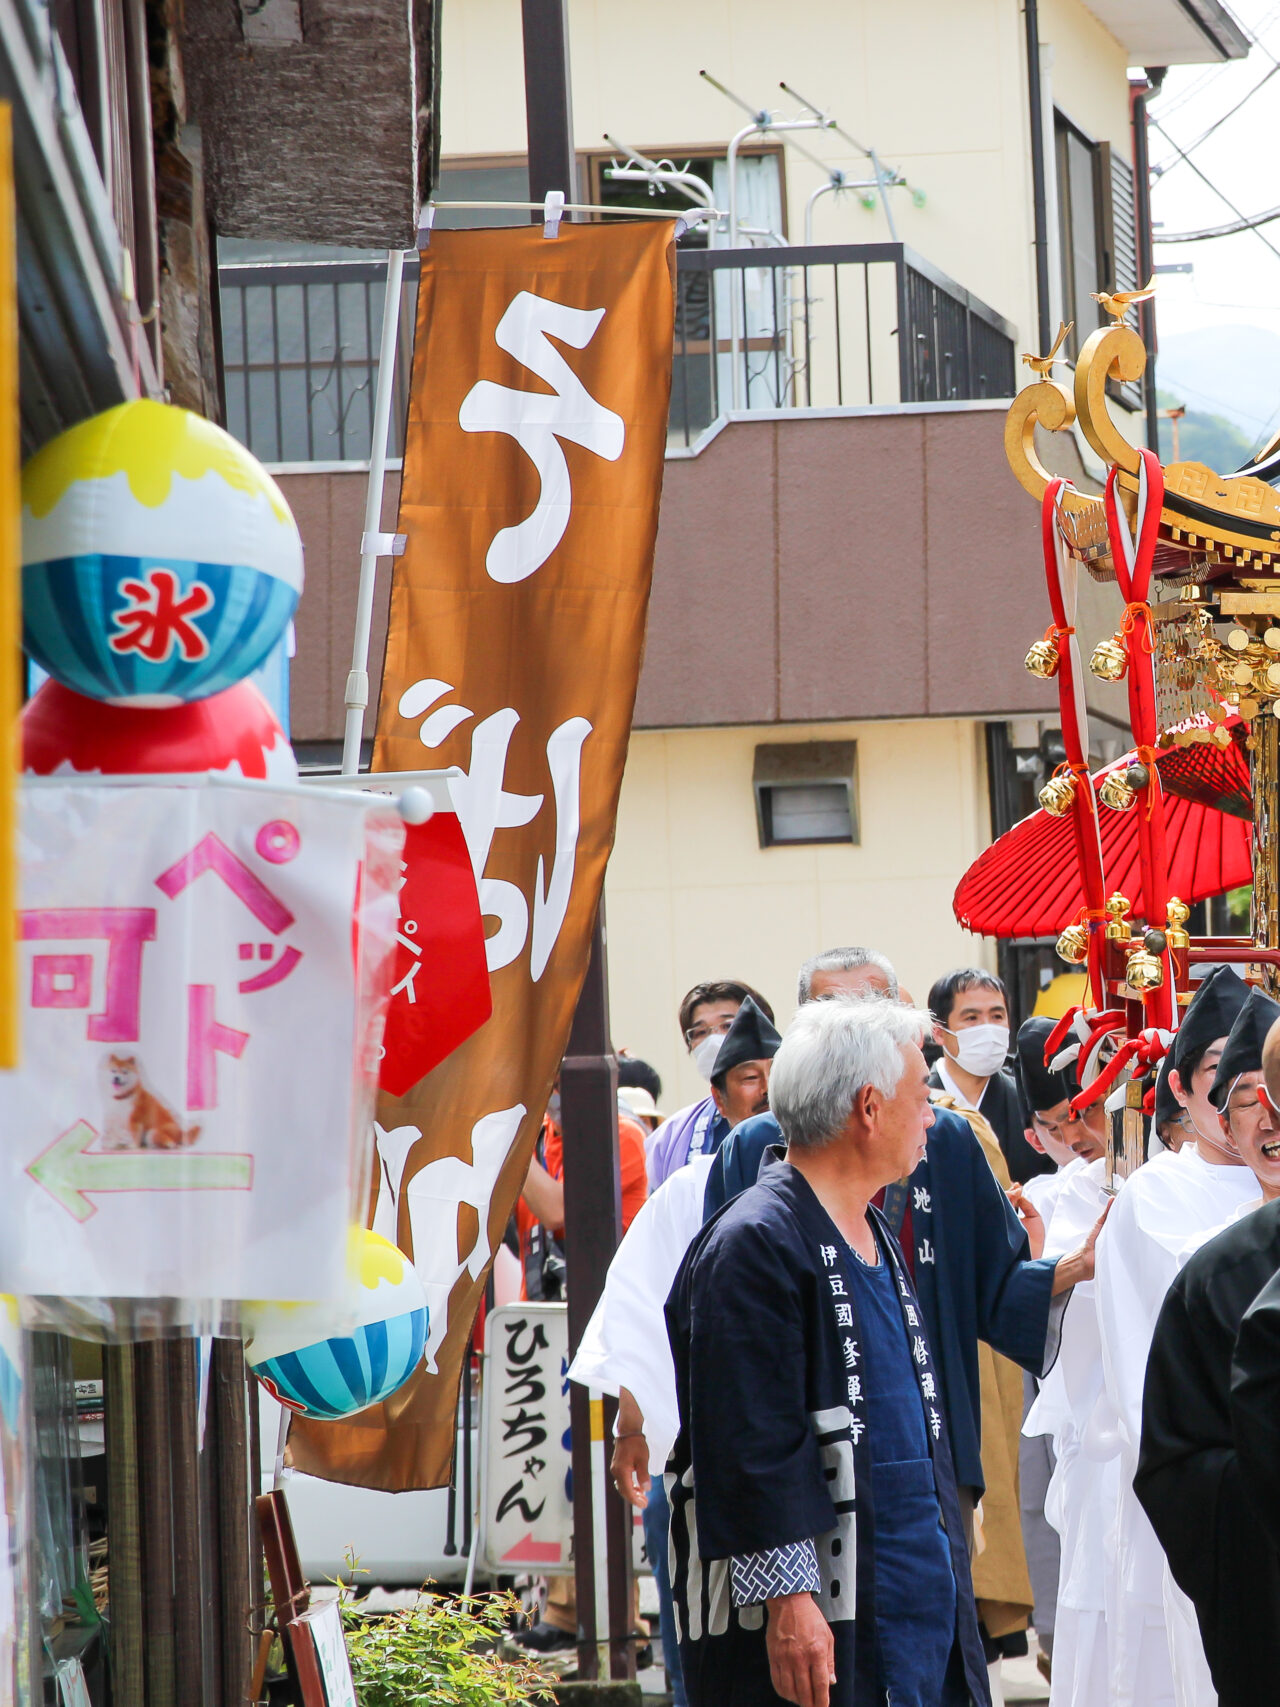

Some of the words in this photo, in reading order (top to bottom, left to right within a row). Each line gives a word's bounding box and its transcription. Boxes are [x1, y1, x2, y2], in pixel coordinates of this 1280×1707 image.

[108, 567, 213, 662] 氷
[15, 906, 157, 1042] 可
[154, 818, 304, 1111] ペット
[391, 860, 422, 1004] ペイ
[913, 1146, 936, 1266] 地山
[495, 1317, 551, 1524] ひろちゃん
